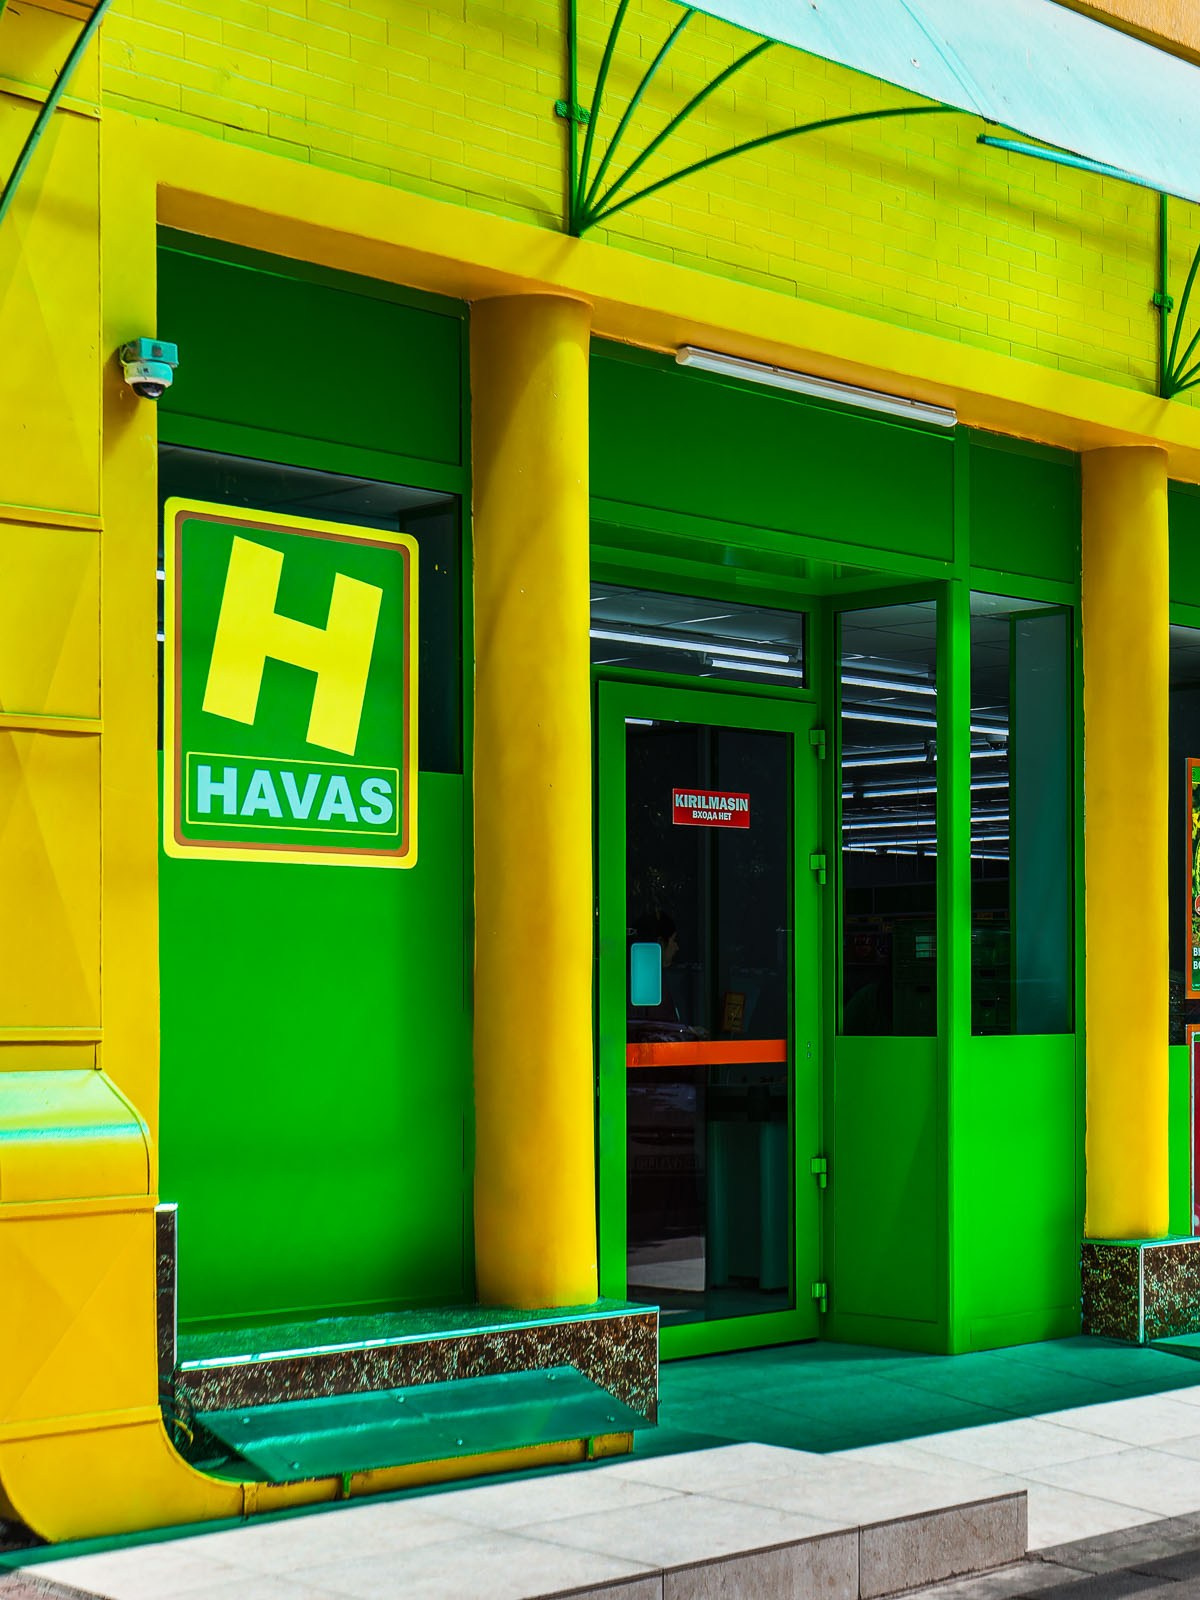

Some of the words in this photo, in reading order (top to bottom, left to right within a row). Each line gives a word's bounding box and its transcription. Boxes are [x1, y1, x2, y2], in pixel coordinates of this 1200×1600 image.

[202, 535, 383, 756] H
[196, 765, 393, 825] HAVAS
[675, 793, 749, 812] KIRILMASIN
[692, 810, 718, 821] ВХОДА
[718, 812, 732, 821] НЕТ
